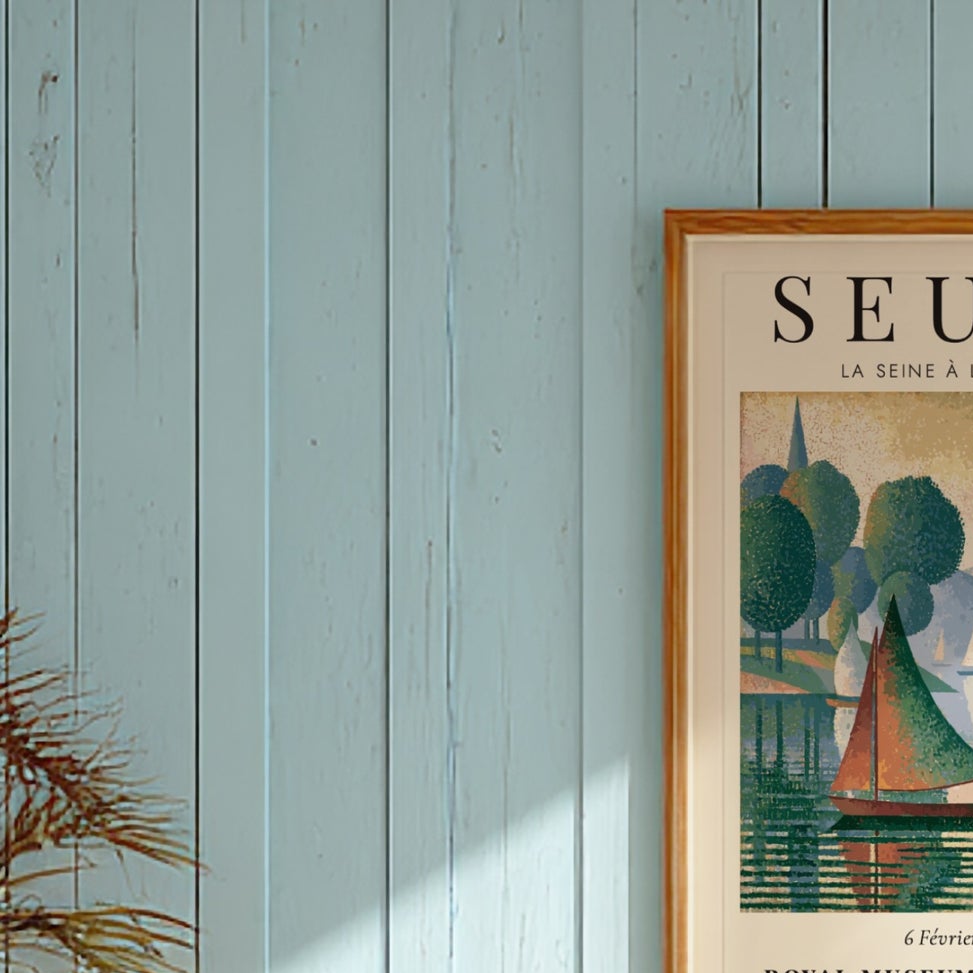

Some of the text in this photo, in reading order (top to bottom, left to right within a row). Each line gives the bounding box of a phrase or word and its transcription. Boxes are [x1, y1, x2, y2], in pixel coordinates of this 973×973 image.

[841, 363, 865, 379] LA
[876, 363, 935, 379] SEINE
[945, 358, 959, 379] À
[903, 928, 915, 946] 6
